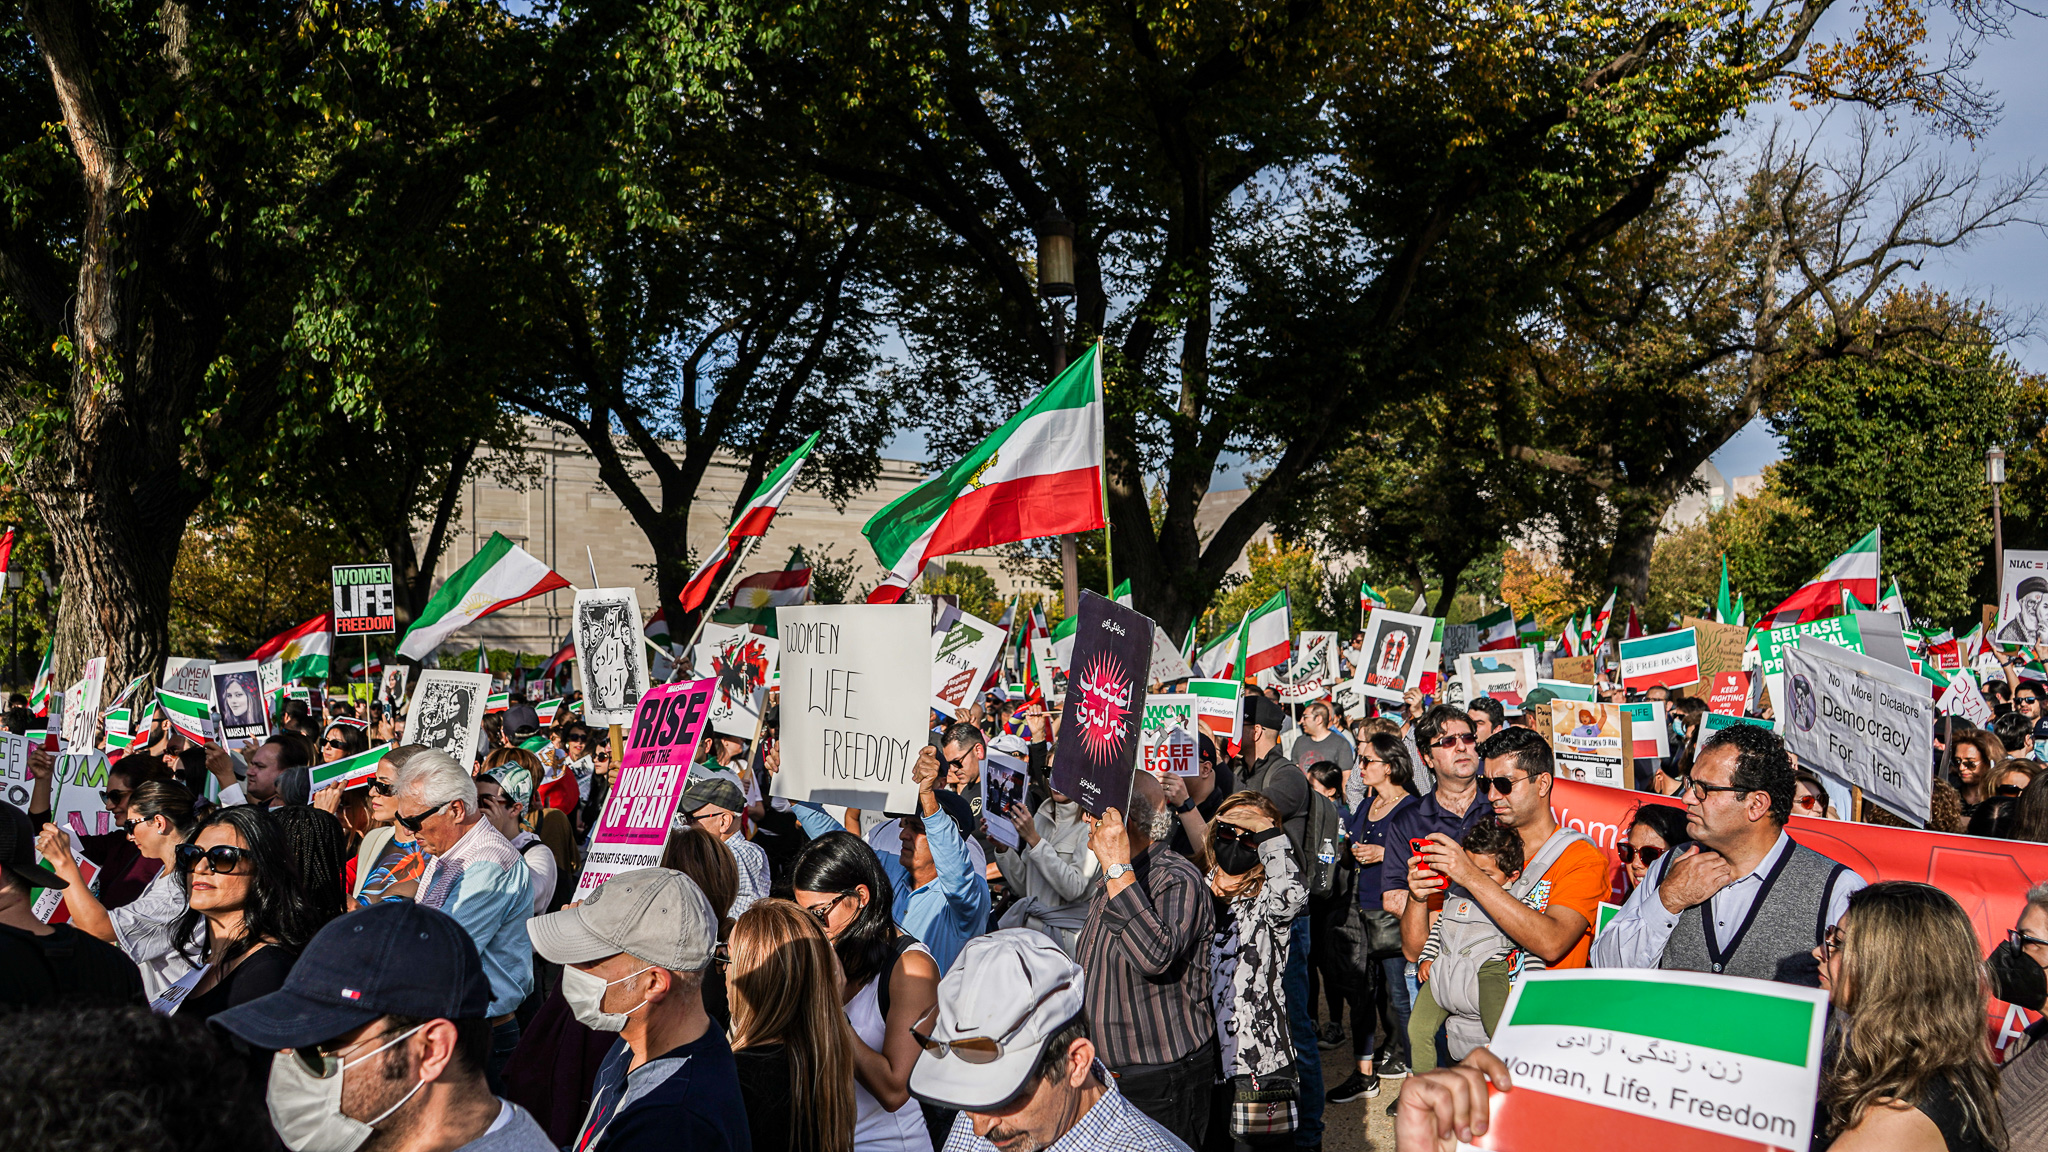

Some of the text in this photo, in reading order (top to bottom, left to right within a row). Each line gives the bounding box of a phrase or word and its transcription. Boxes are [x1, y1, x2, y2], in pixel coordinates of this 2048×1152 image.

[2009, 559, 2033, 569] NIAC
[334, 567, 392, 585] WOMEN
[334, 584, 394, 617] LIFE
[336, 615, 394, 632] FREEDOM
[1770, 618, 1842, 643] RELEASE
[785, 622, 840, 655] WOMEN
[1636, 654, 1683, 671] FREE IRAN
[171, 667, 210, 679] WOMEN
[1366, 673, 1405, 690] MURDERER
[178, 679, 199, 692] LIFE
[808, 667, 864, 720] LIFE
[945, 681, 968, 695] change
[1080, 664, 1134, 713] اعتصاب
[1720, 685, 1739, 694] KEEP
[1710, 693, 1745, 703] FIGHTING
[1828, 672, 1920, 719] No More Dictators
[1146, 704, 1191, 719] WOM
[1210, 706, 1234, 716] Freedom
[1632, 707, 1650, 717] LIFE
[632, 691, 707, 750] RISE
[1141, 716, 1166, 731] AN
[1822, 695, 1911, 756] Democracy
[225, 725, 264, 738] MAHSA AMINI
[1145, 744, 1194, 758] FREE
[1608, 738, 1618, 747] IRAN
[640, 749, 672, 764] WITH THE
[823, 729, 911, 785] FREEDOM
[1145, 757, 1189, 772] DOM
[1577, 754, 1600, 763] happening
[1829, 732, 1902, 789] For Iran
[616, 764, 682, 797] WOMEN
[606, 796, 672, 828] OF IRAN
[586, 852, 660, 867] INTERNET IS SHUT DOWN
[580, 871, 594, 888] BE
[1555, 1032, 1745, 1084] زن، زندگی، آزادی
[1602, 1072, 1658, 1110] Life,
[1669, 1087, 1797, 1139] Freedom
